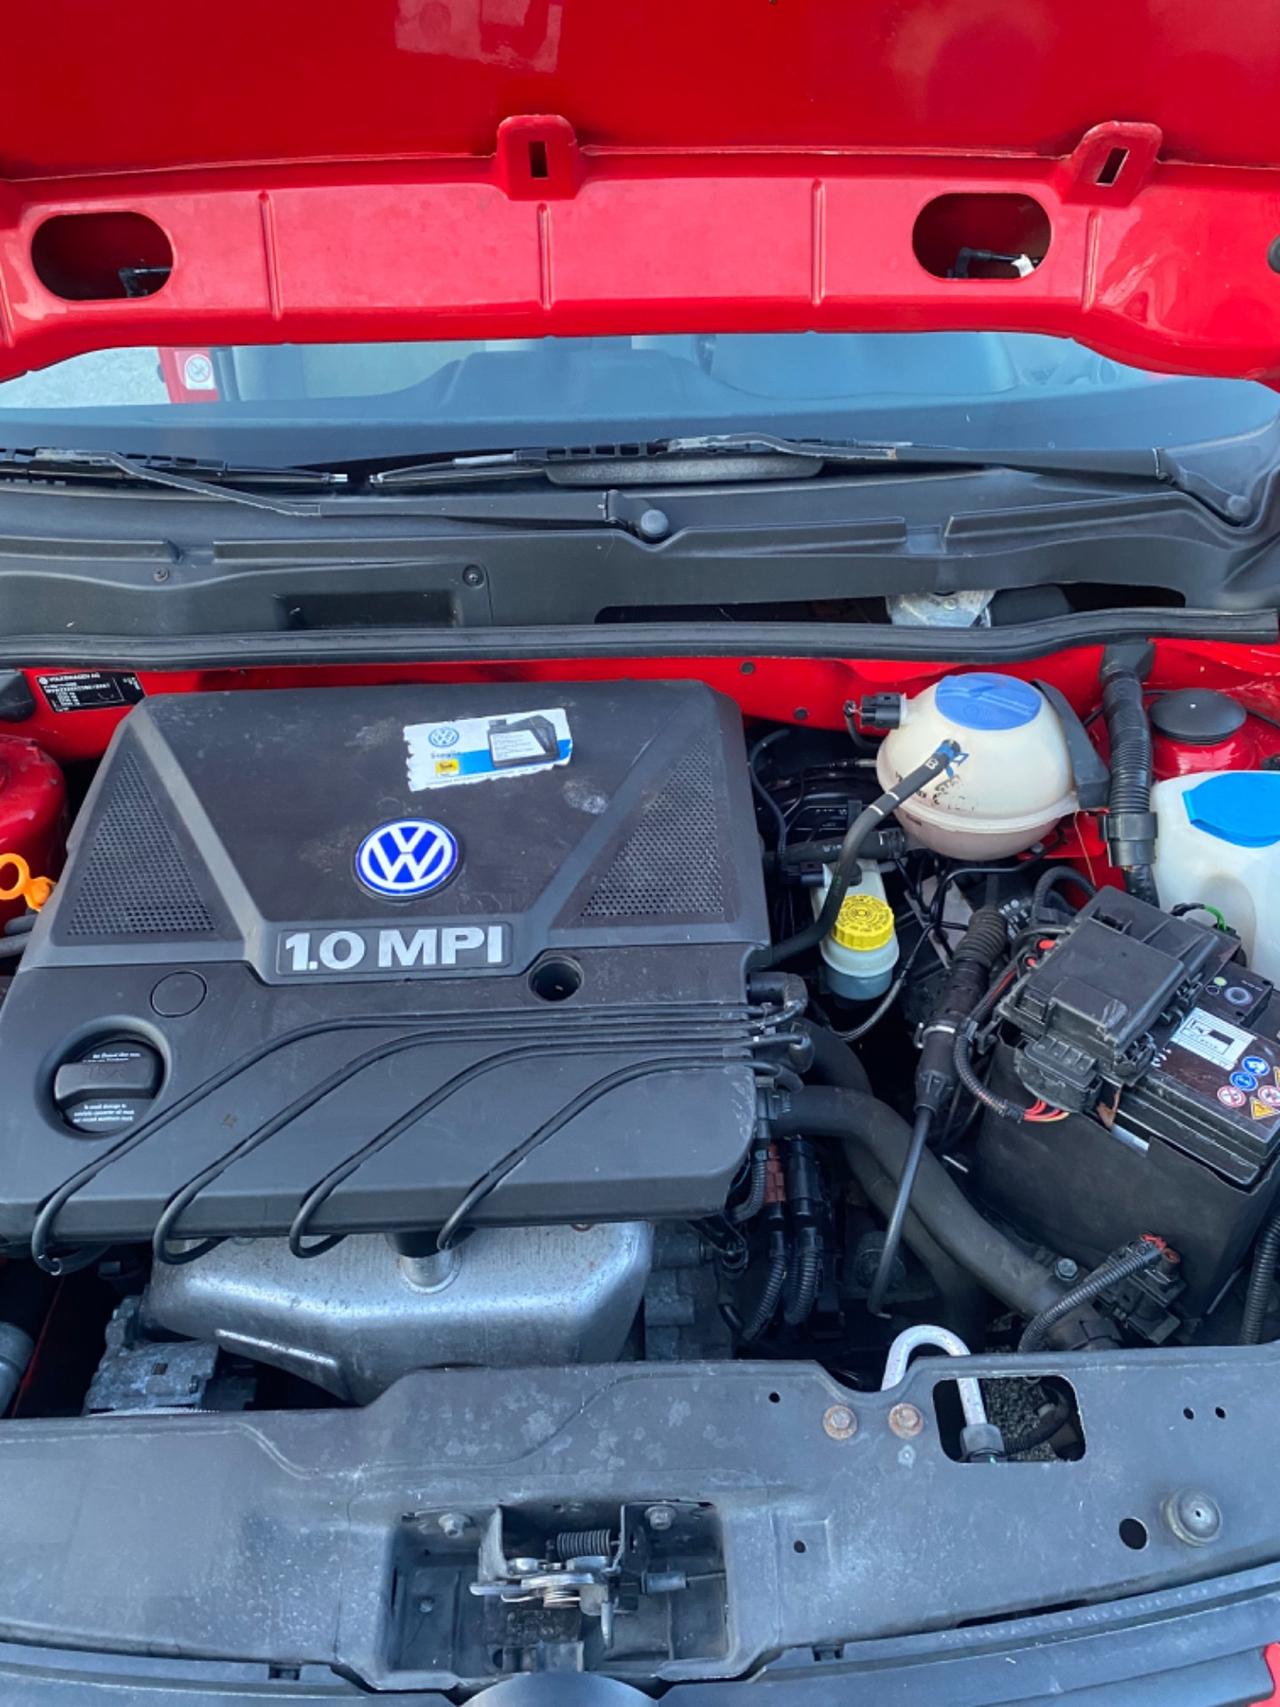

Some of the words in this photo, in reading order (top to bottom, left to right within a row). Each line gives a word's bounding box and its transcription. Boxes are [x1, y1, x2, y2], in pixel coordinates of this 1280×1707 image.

[359, 820, 455, 893] VW
[285, 930, 366, 971] 1.0
[378, 925, 503, 968] MPI
